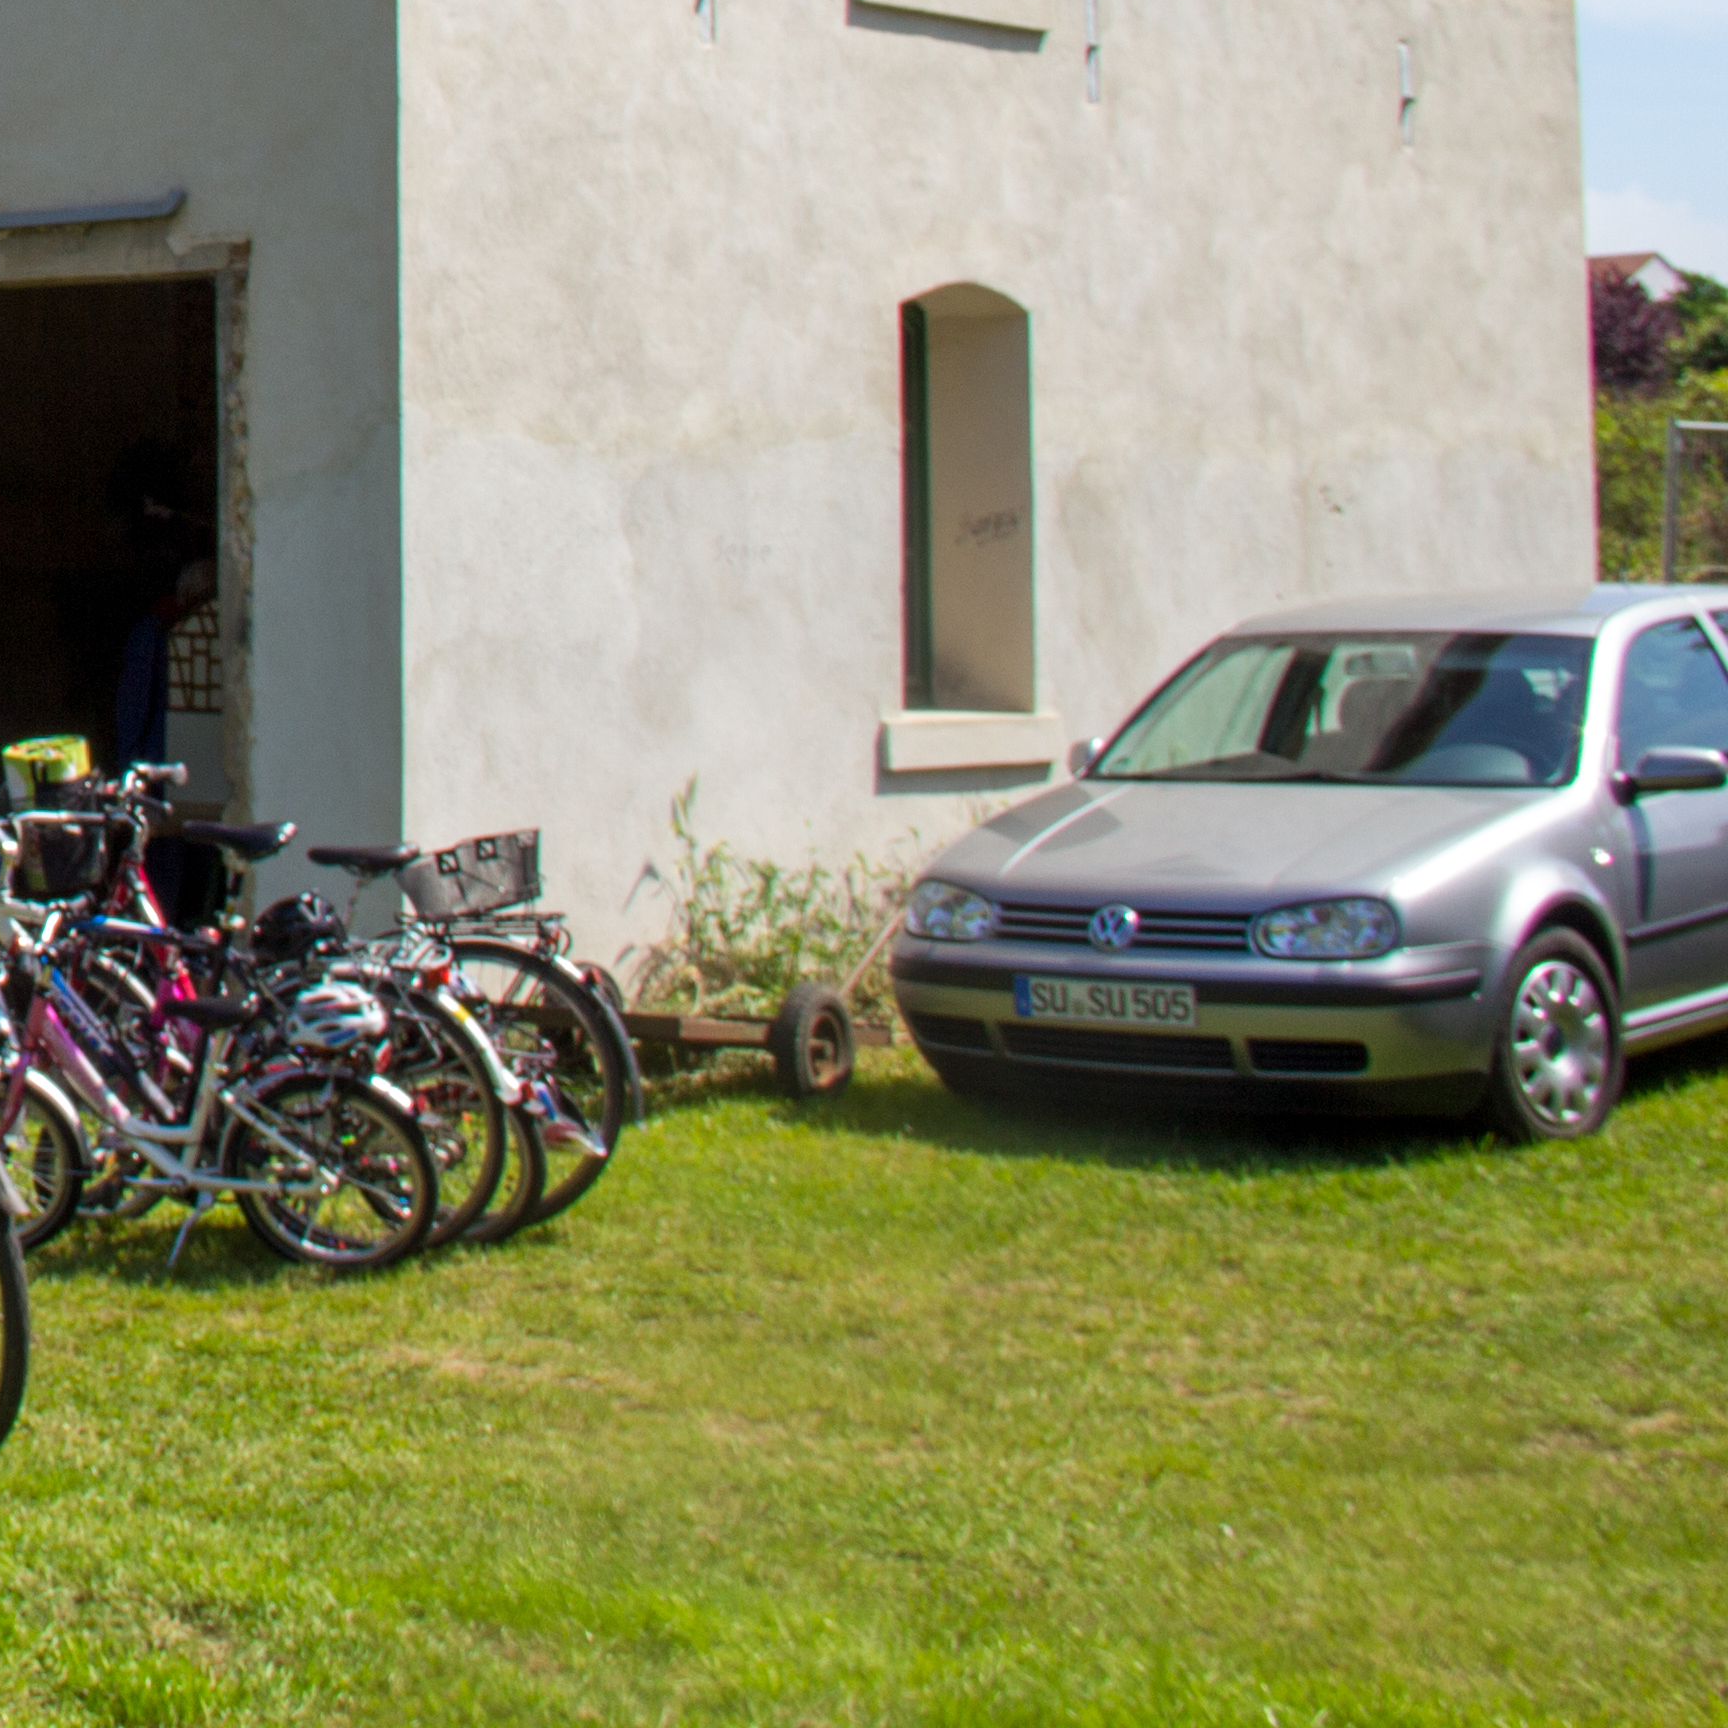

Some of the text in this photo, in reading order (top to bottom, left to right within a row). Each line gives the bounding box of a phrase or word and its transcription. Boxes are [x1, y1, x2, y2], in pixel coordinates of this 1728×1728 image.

[1031, 982, 1190, 1021] SU SU 505
